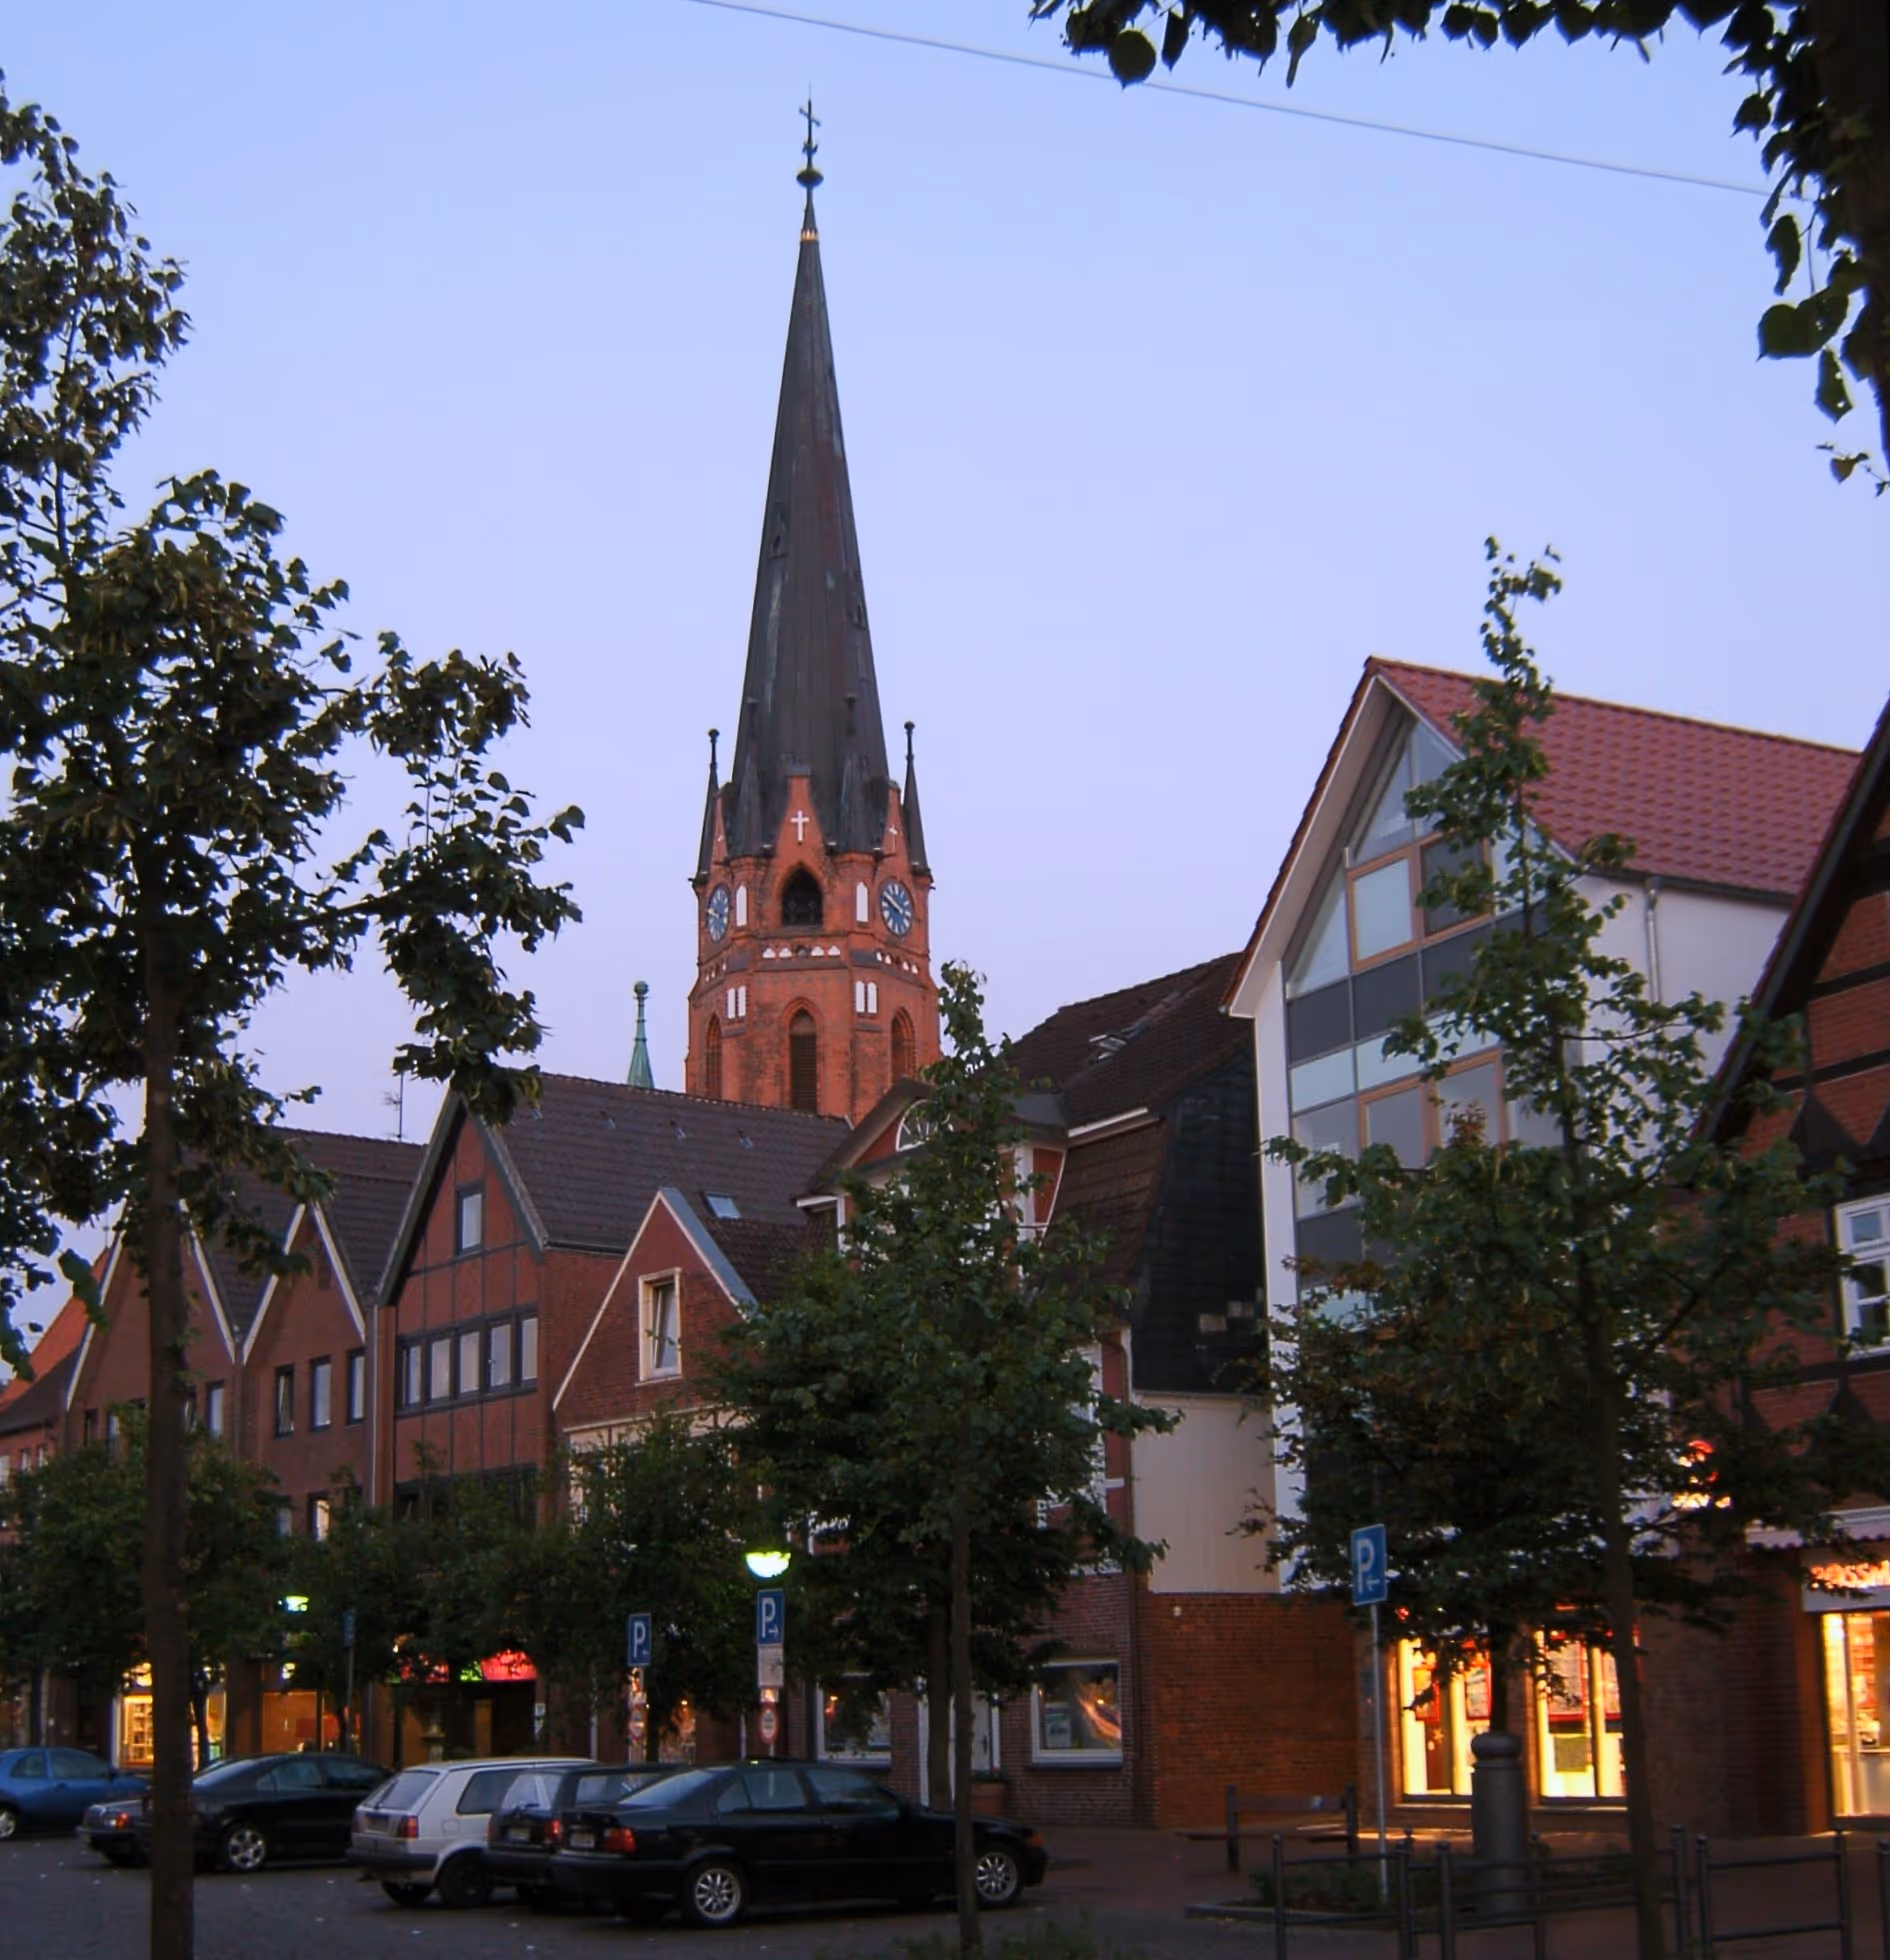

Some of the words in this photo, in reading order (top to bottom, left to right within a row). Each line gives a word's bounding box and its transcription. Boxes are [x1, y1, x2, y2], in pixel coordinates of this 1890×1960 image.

[1357, 1538, 1374, 1593] P
[761, 1597, 776, 1639] P
[633, 1620, 646, 1659] P
